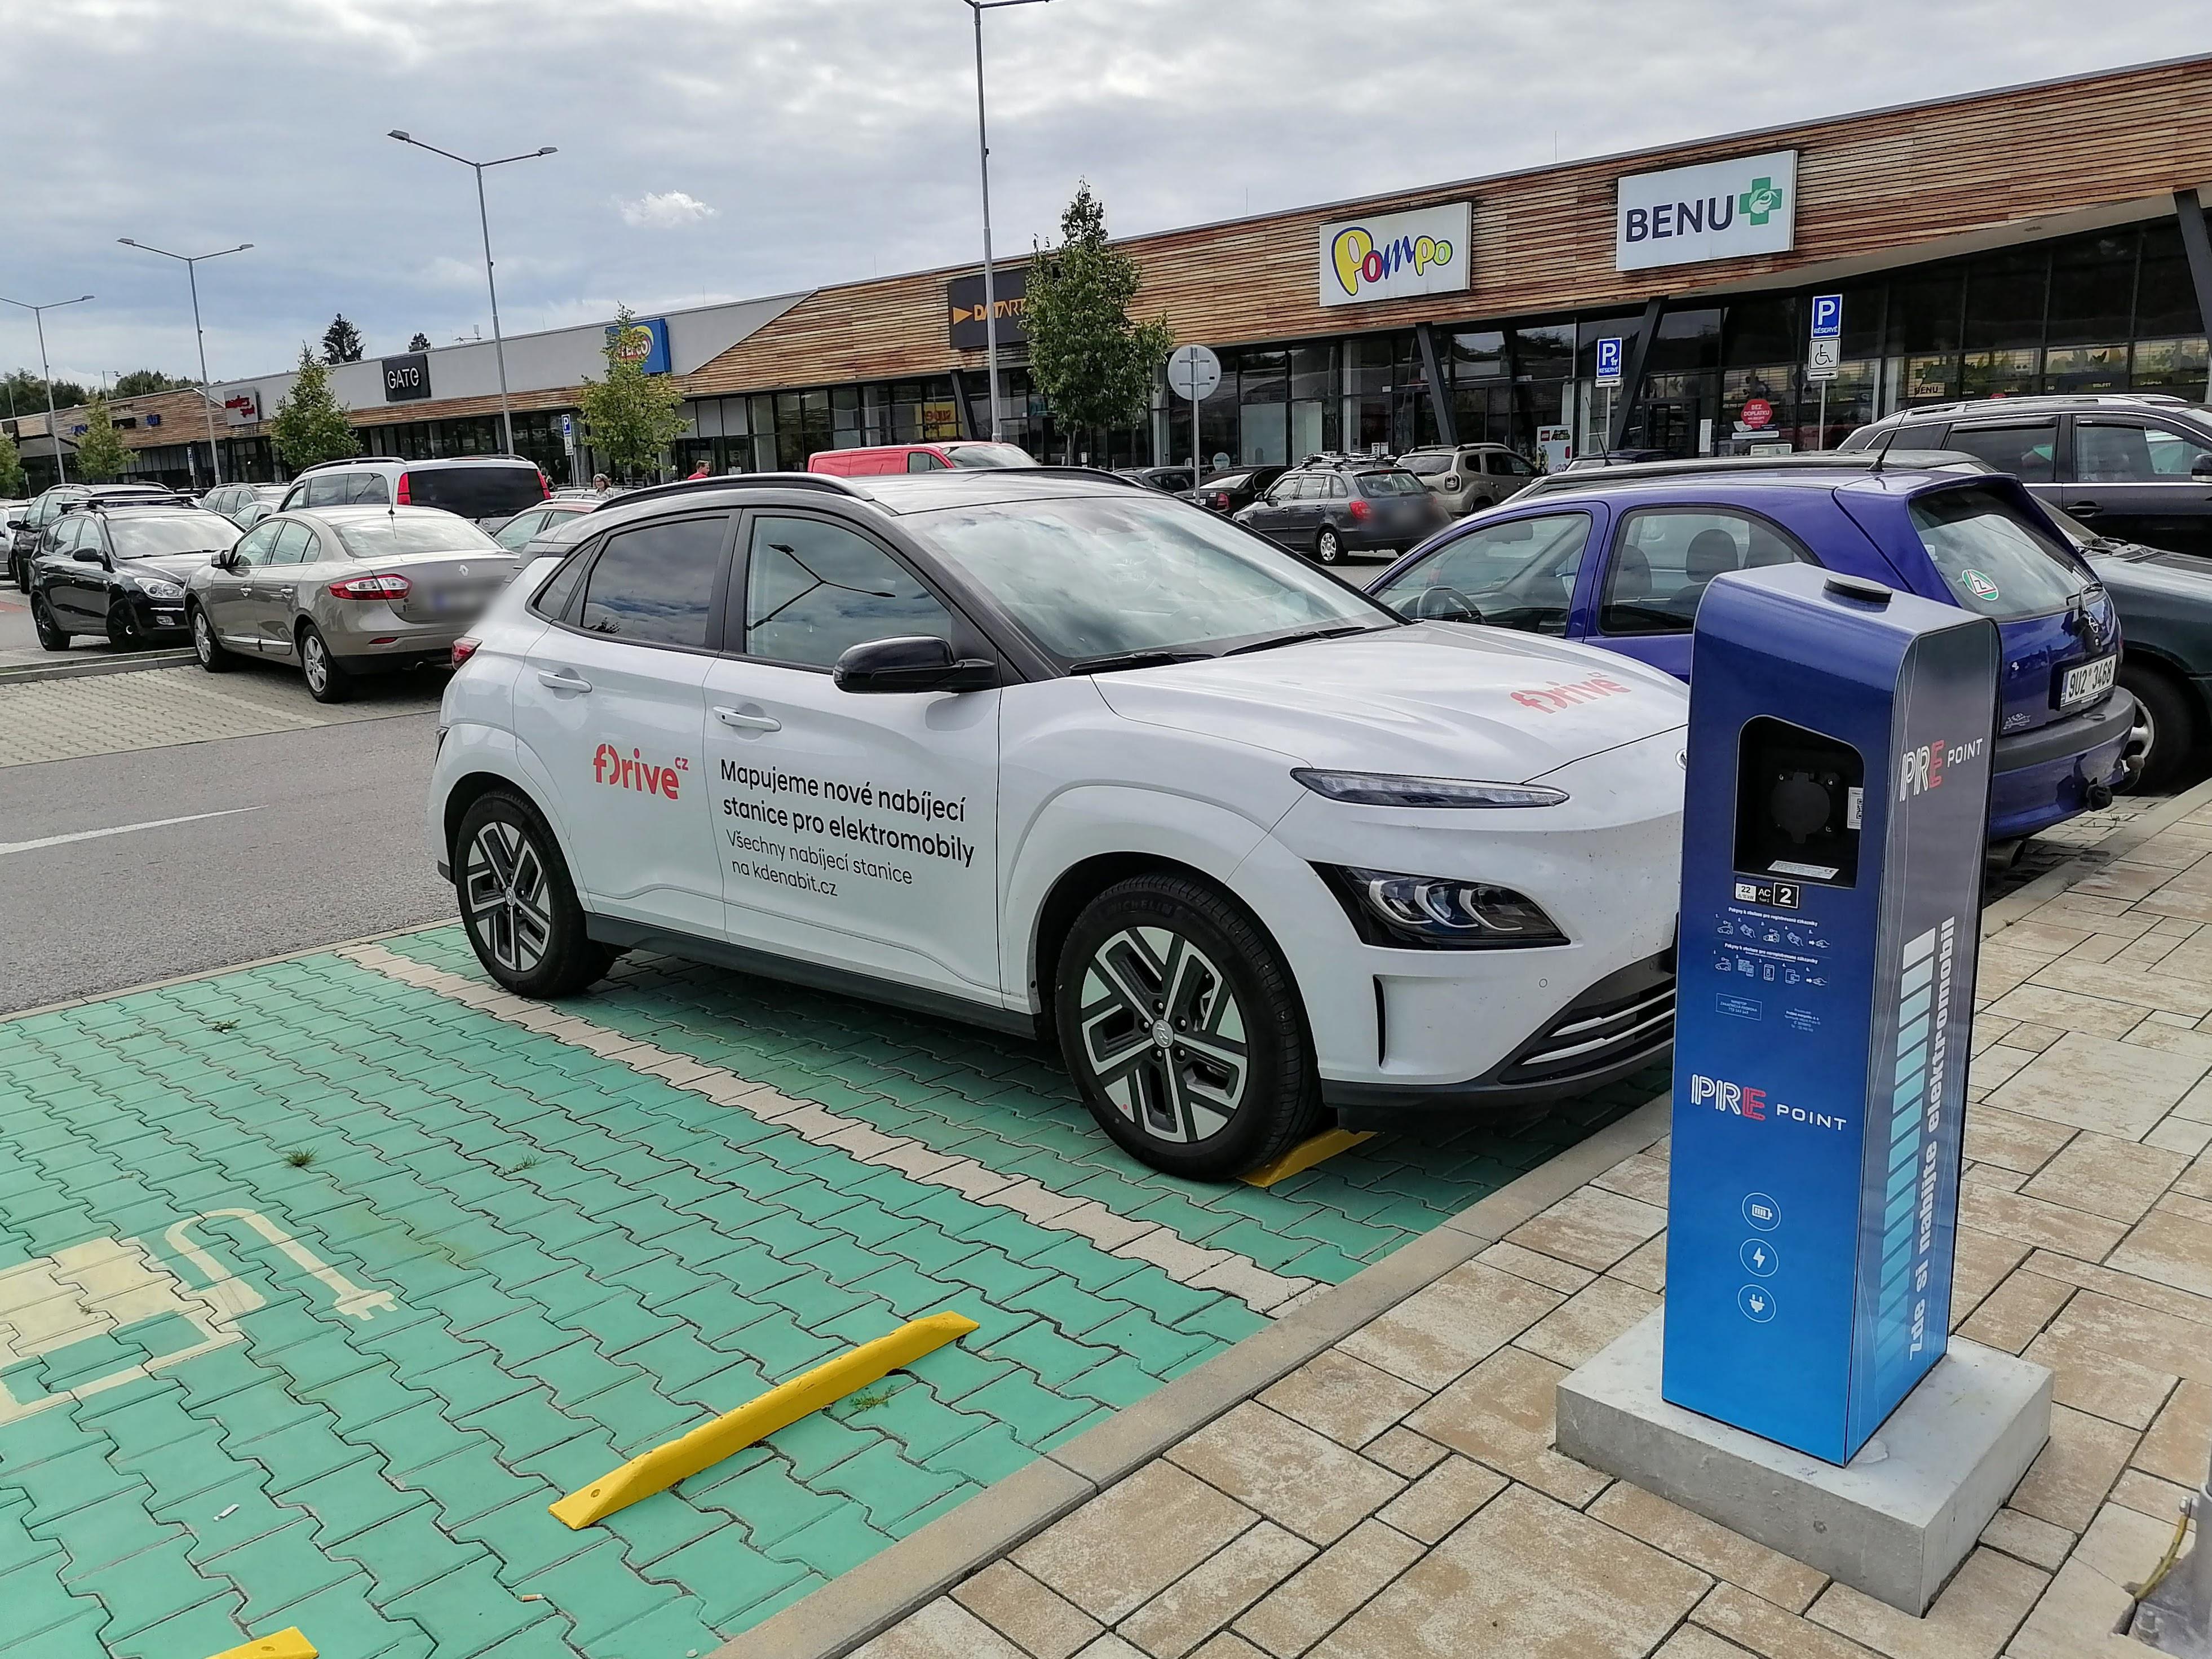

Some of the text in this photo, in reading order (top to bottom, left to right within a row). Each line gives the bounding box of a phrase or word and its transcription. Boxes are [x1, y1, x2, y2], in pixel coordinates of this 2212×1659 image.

[1626, 194, 1733, 242] BENU
[1331, 227, 1453, 296] Pompo
[1813, 325, 1838, 334] RÉSERVÉ
[1817, 300, 1835, 325] P
[1602, 343, 1617, 366] P
[2069, 660, 2112, 698] 9U2 3468
[721, 758, 966, 822] Mapujeme nové nabíjecí
[1899, 738, 1983, 802] PRE POINT
[723, 797, 975, 868] stanice pro elektromobily
[725, 829, 913, 884] Všechny nabíjecí stanice
[732, 860, 838, 896] na kdenabit.cz
[1758, 888, 1772, 897] AC
[1780, 887, 1792, 904] 2
[1926, 915, 1956, 1134] elektromobil
[1691, 1073, 1847, 1131] PRE POINT
[1915, 1259, 1930, 1293] si
[1909, 1298, 1926, 1361] Zde
